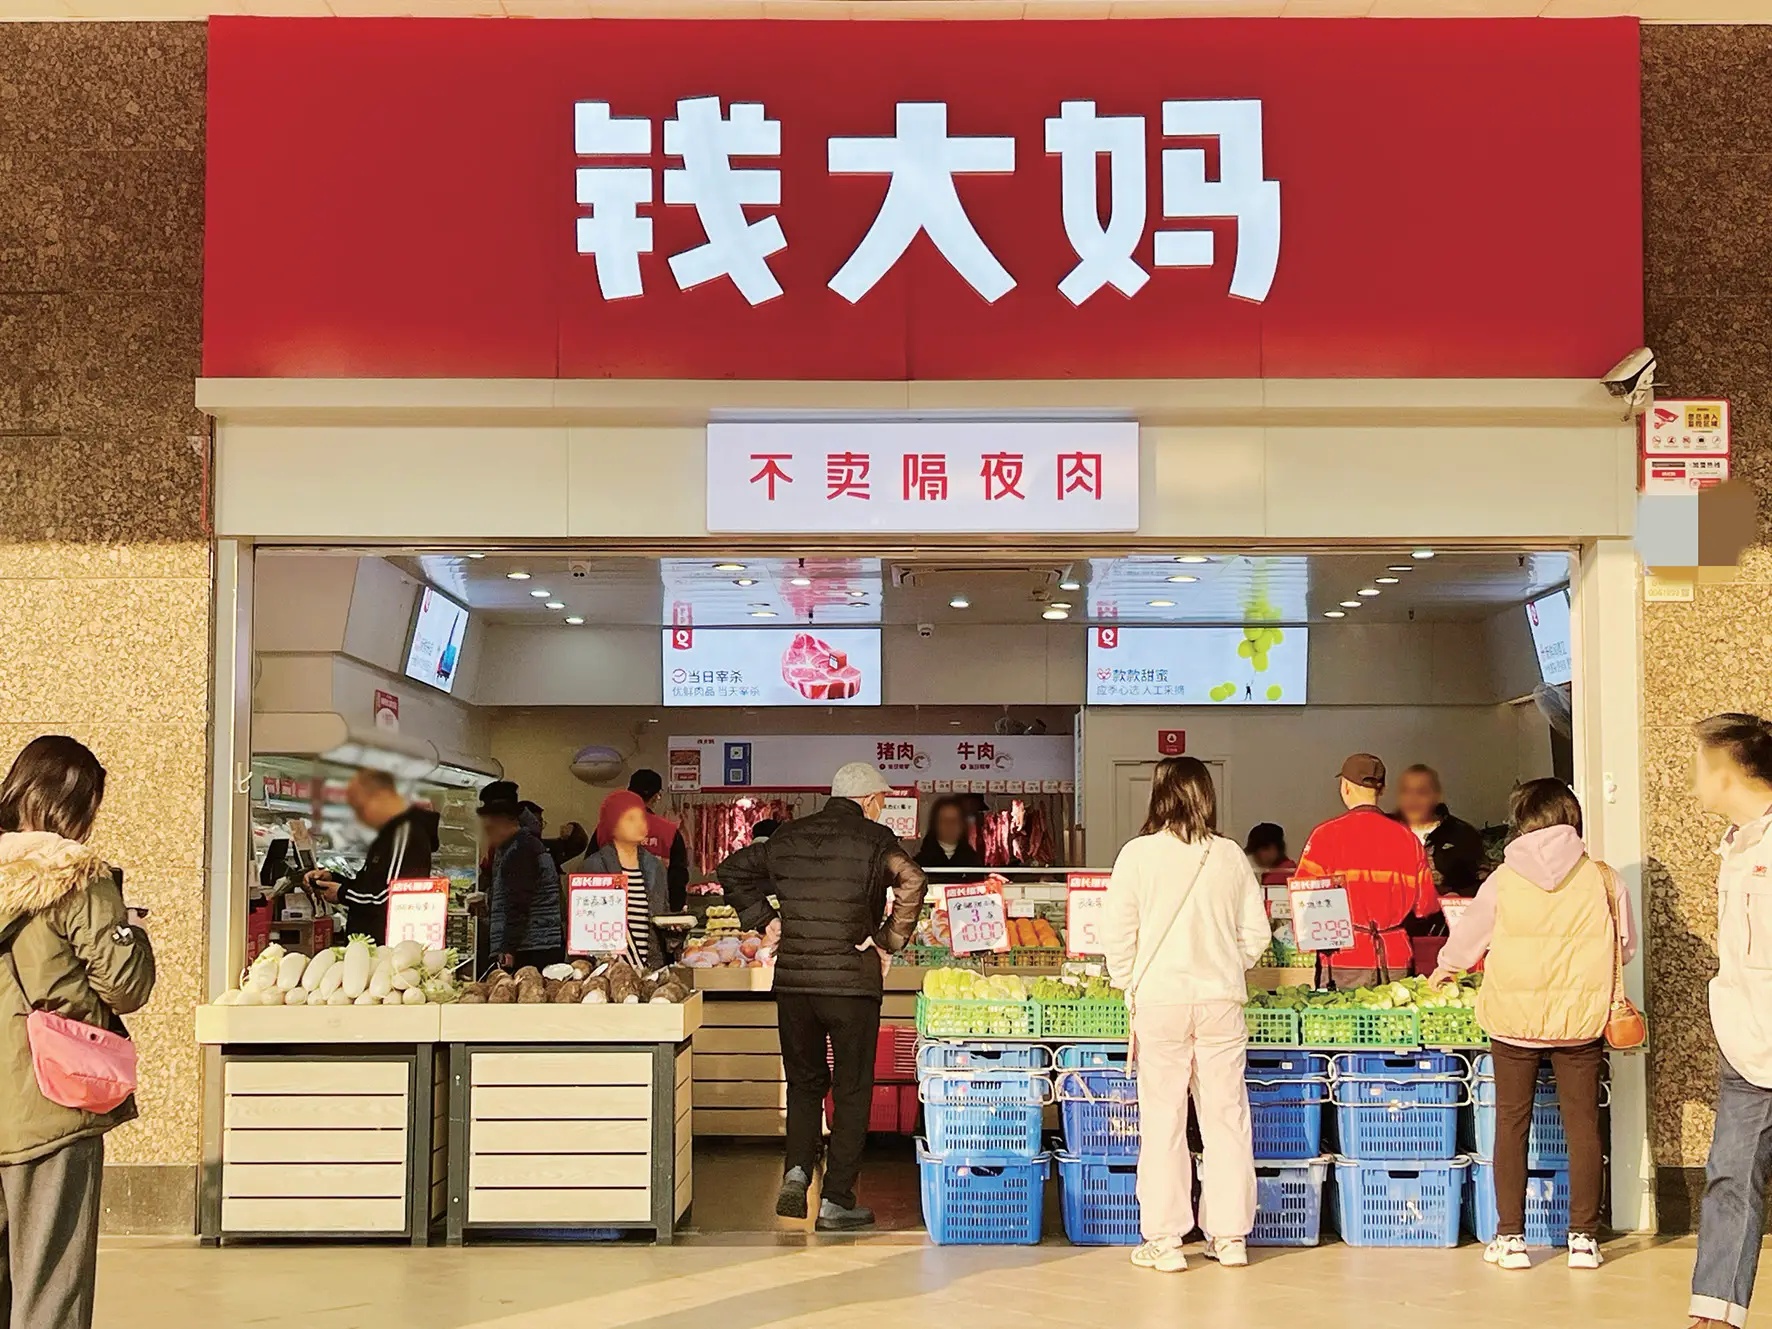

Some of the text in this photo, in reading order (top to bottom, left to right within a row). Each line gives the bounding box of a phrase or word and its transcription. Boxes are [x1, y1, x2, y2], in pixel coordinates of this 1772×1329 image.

[575, 96, 1281, 306] 钱大妈
[749, 450, 1102, 501] 不卖隔夜肉
[688, 669, 743, 683] 当日宰杀
[1113, 668, 1169, 682] 款款甜蜜
[877, 742, 914, 761] 猪肉
[957, 742, 995, 761] 牛肉
[585, 921, 623, 942] 4.68
[1312, 919, 1351, 941] 2.98
